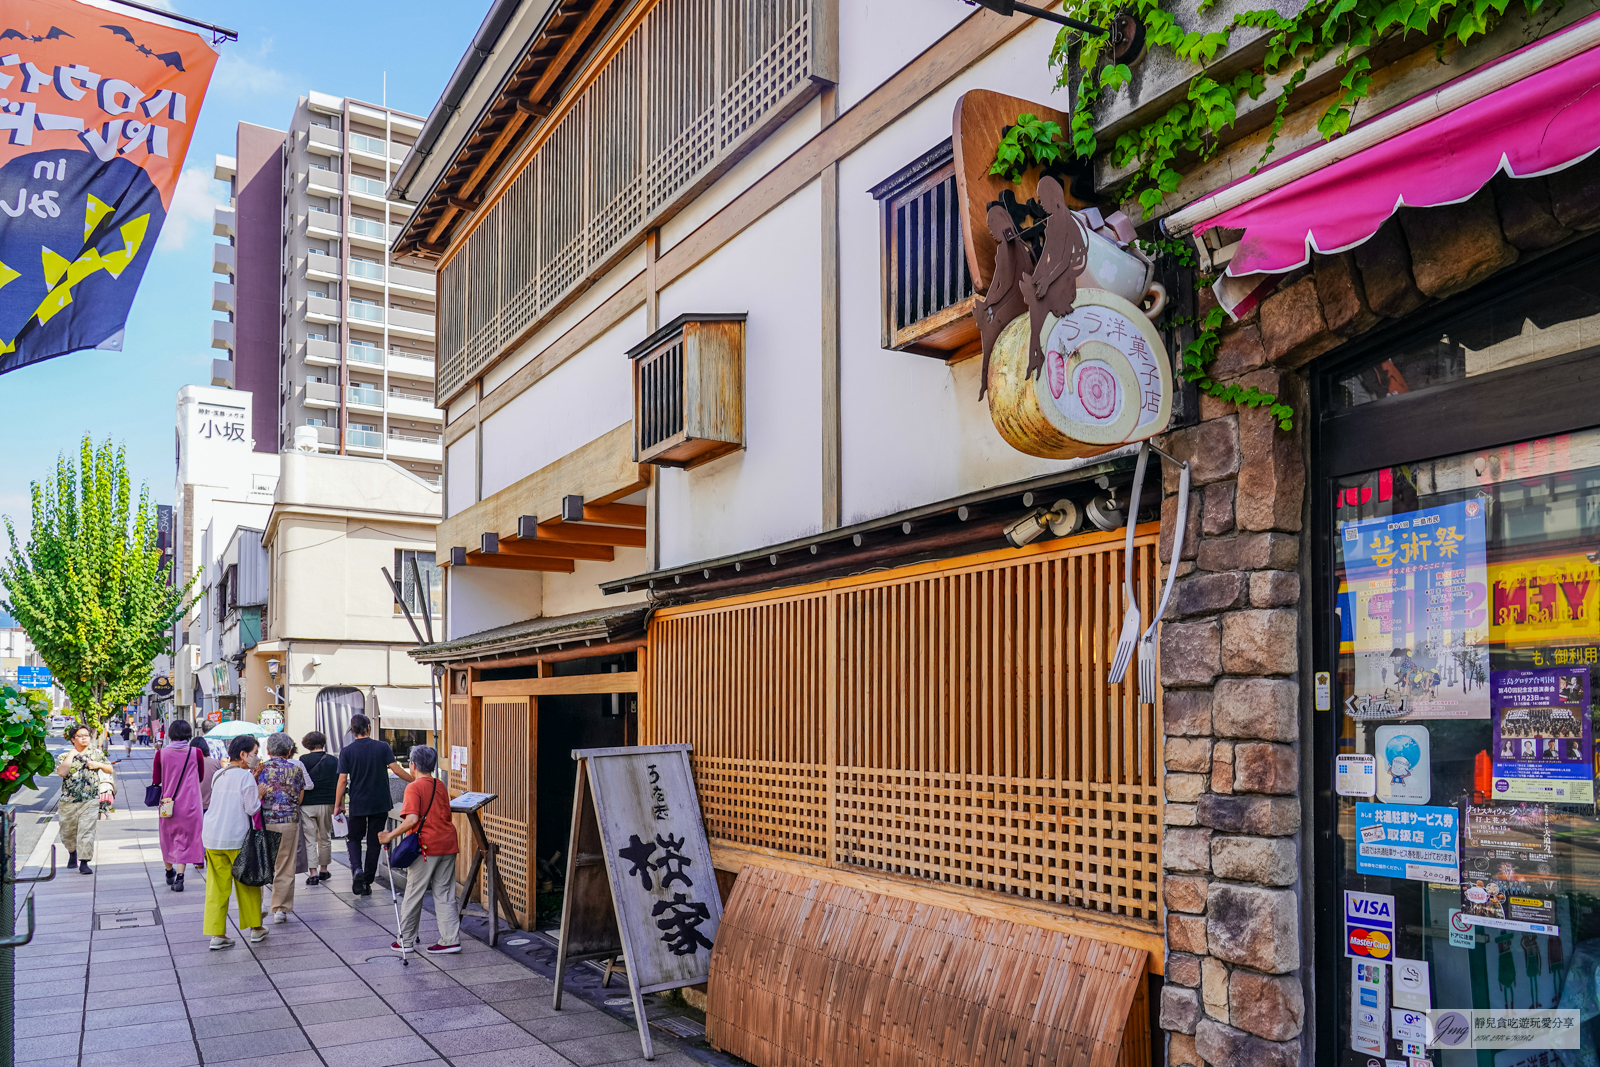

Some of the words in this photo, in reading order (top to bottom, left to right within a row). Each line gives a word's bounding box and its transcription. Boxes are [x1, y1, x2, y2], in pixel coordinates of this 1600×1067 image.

[1061, 312, 1162, 414] ララ洋菓子店
[198, 419, 245, 442] 小坂
[1413, 515, 1441, 528] 三島市民
[1369, 526, 1465, 567] 芸術祭
[1536, 562, 1600, 586] Salon
[1499, 605, 1521, 627] 3F
[1532, 647, 1600, 666] も、御利用
[1498, 686, 1556, 694] 第40回記念定期演奏会
[1499, 676, 1555, 686] 三島グロリア合唱団
[1514, 694, 1540, 702] 11月23日
[1374, 809, 1454, 828] 共通駐車サービス券
[1475, 816, 1508, 825] 打上花火
[1387, 828, 1425, 843] 取扱店
[1361, 845, 1455, 863] 当店では共通駐車サービス券を差し上げております。
[619, 832, 715, 957] 桜家
[1350, 898, 1390, 918] VISA
[1350, 936, 1390, 950] MasterCard
[1450, 932, 1474, 940] ドアに注意
[1357, 1035, 1380, 1045] DISCOVER
